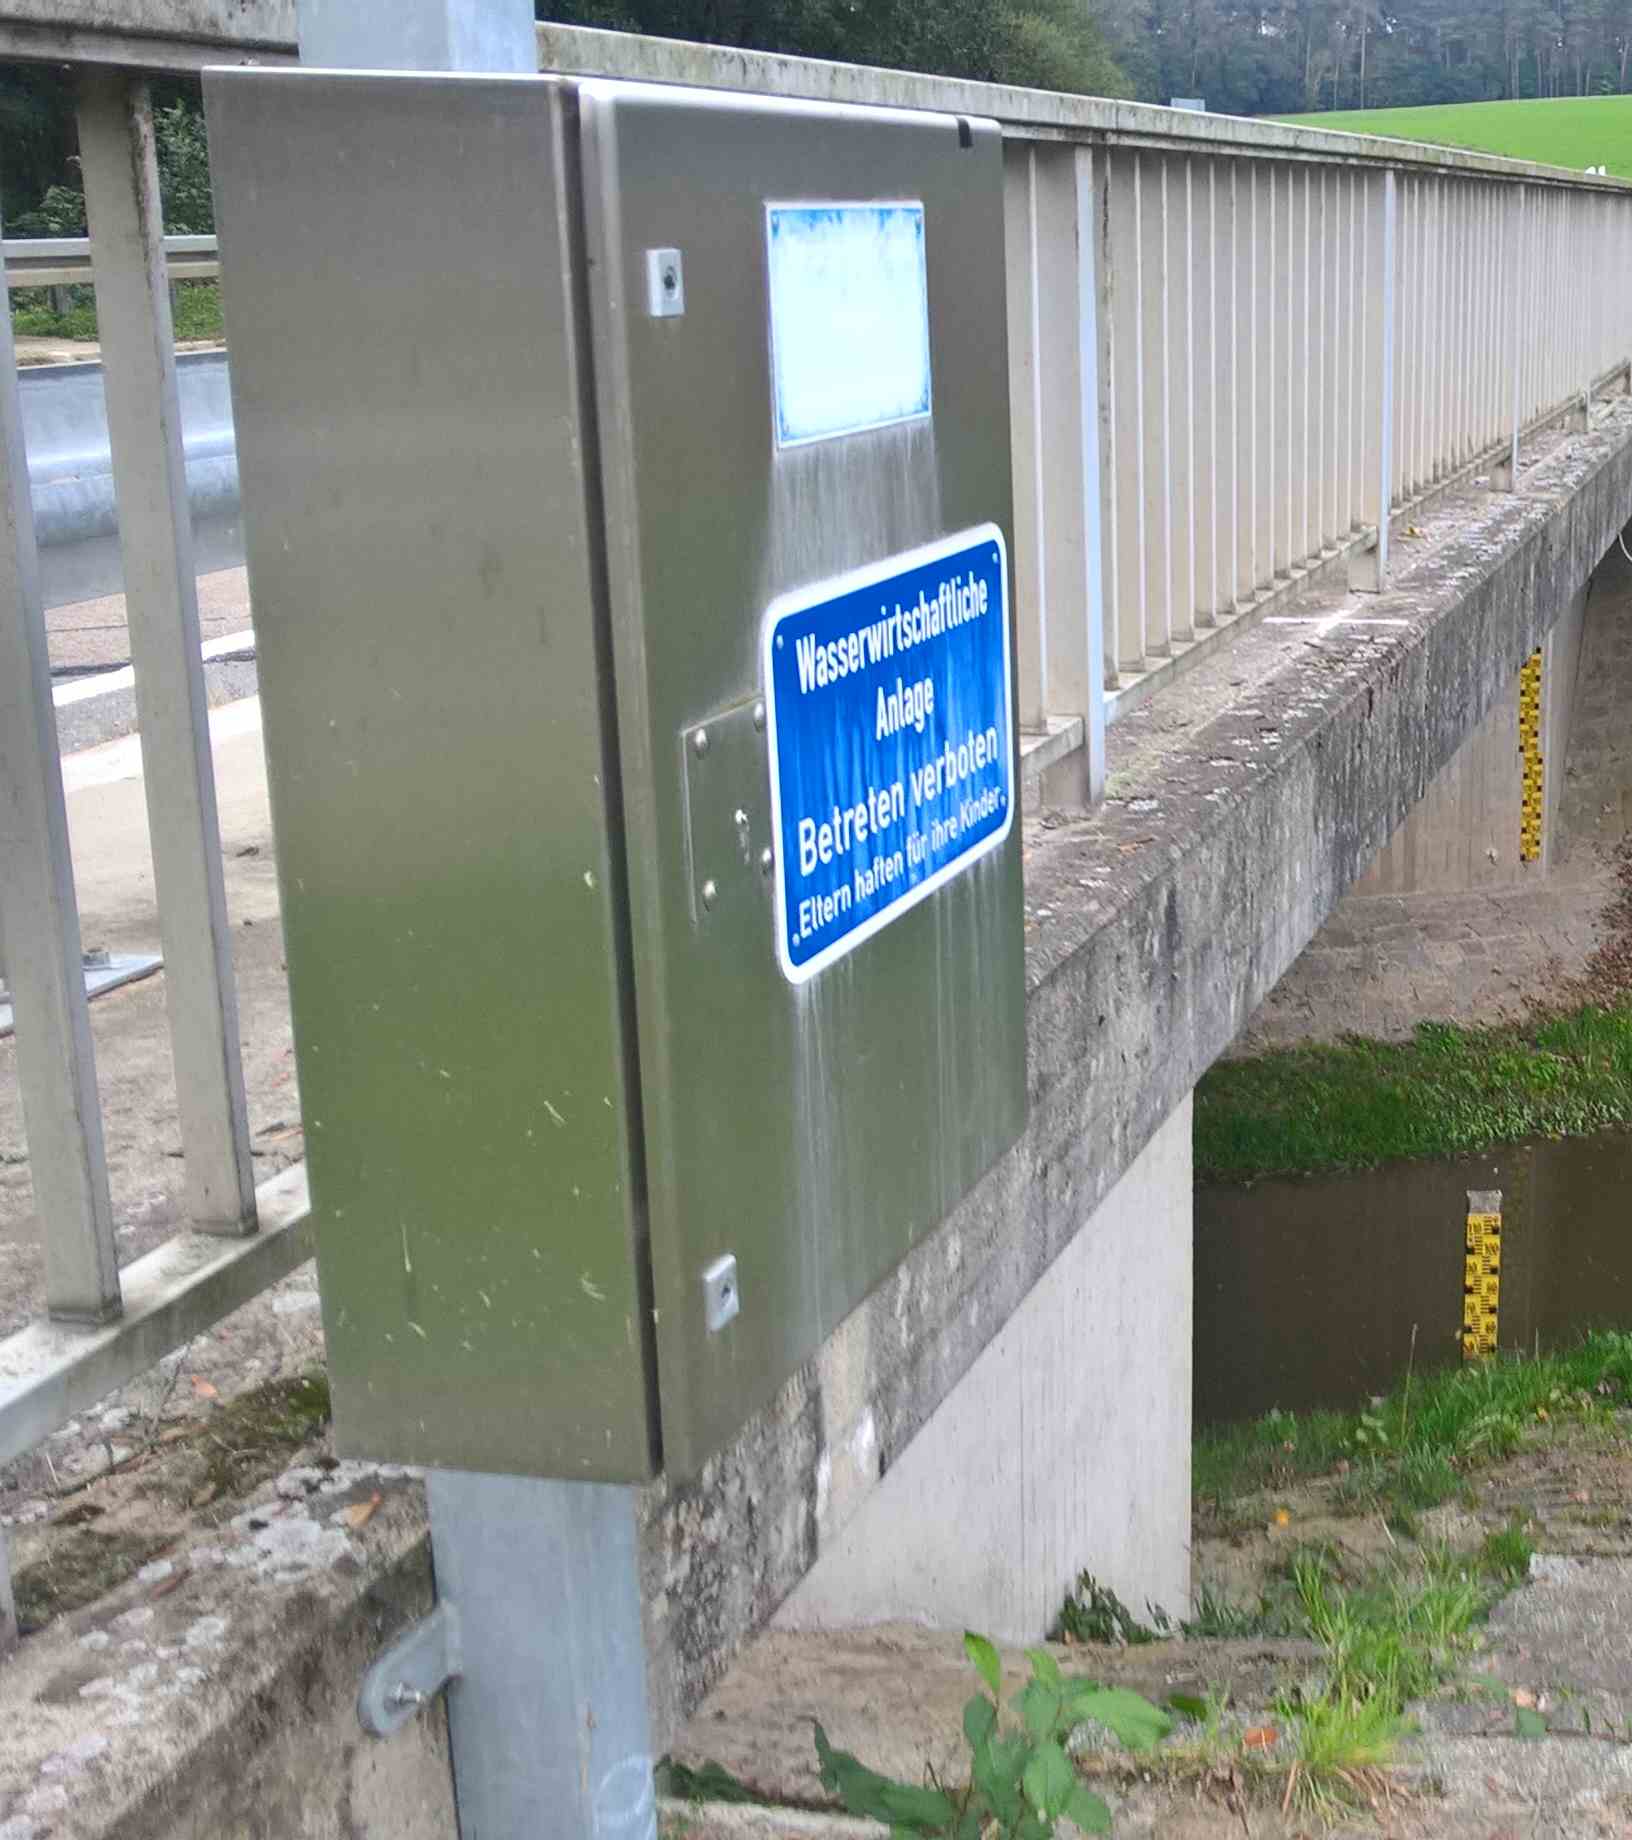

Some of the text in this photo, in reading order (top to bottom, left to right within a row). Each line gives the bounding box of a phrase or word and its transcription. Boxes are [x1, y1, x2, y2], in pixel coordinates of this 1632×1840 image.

[796, 571, 988, 695] Wasserwirtschaftliche
[876, 677, 934, 741] Anlage
[799, 726, 998, 877] Betreten verboten
[799, 884, 852, 939] Eltern
[855, 851, 904, 902] haften
[906, 831, 928, 868] für
[931, 815, 958, 853] ihre
